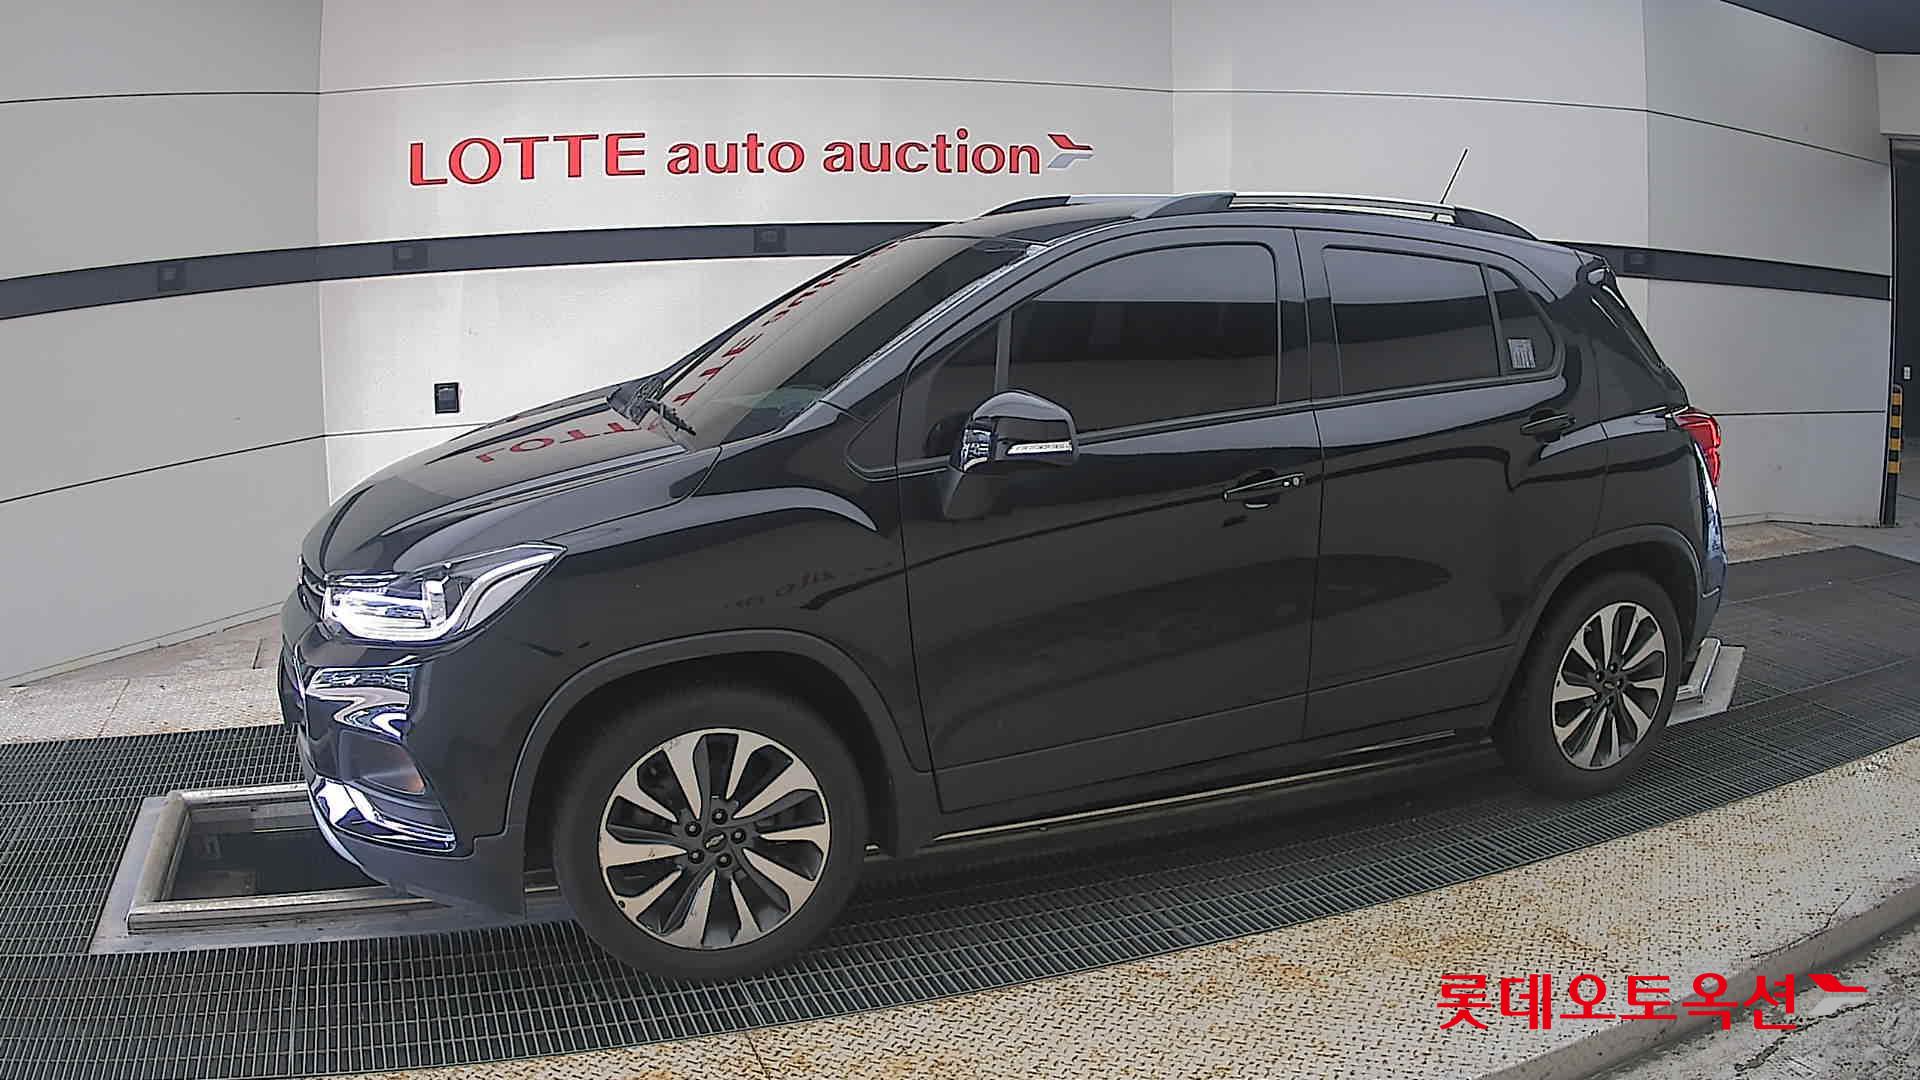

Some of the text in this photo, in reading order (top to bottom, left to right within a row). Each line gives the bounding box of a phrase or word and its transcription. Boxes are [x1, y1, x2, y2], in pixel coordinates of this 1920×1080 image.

[408, 128, 1042, 187] LOTTE auto auction
